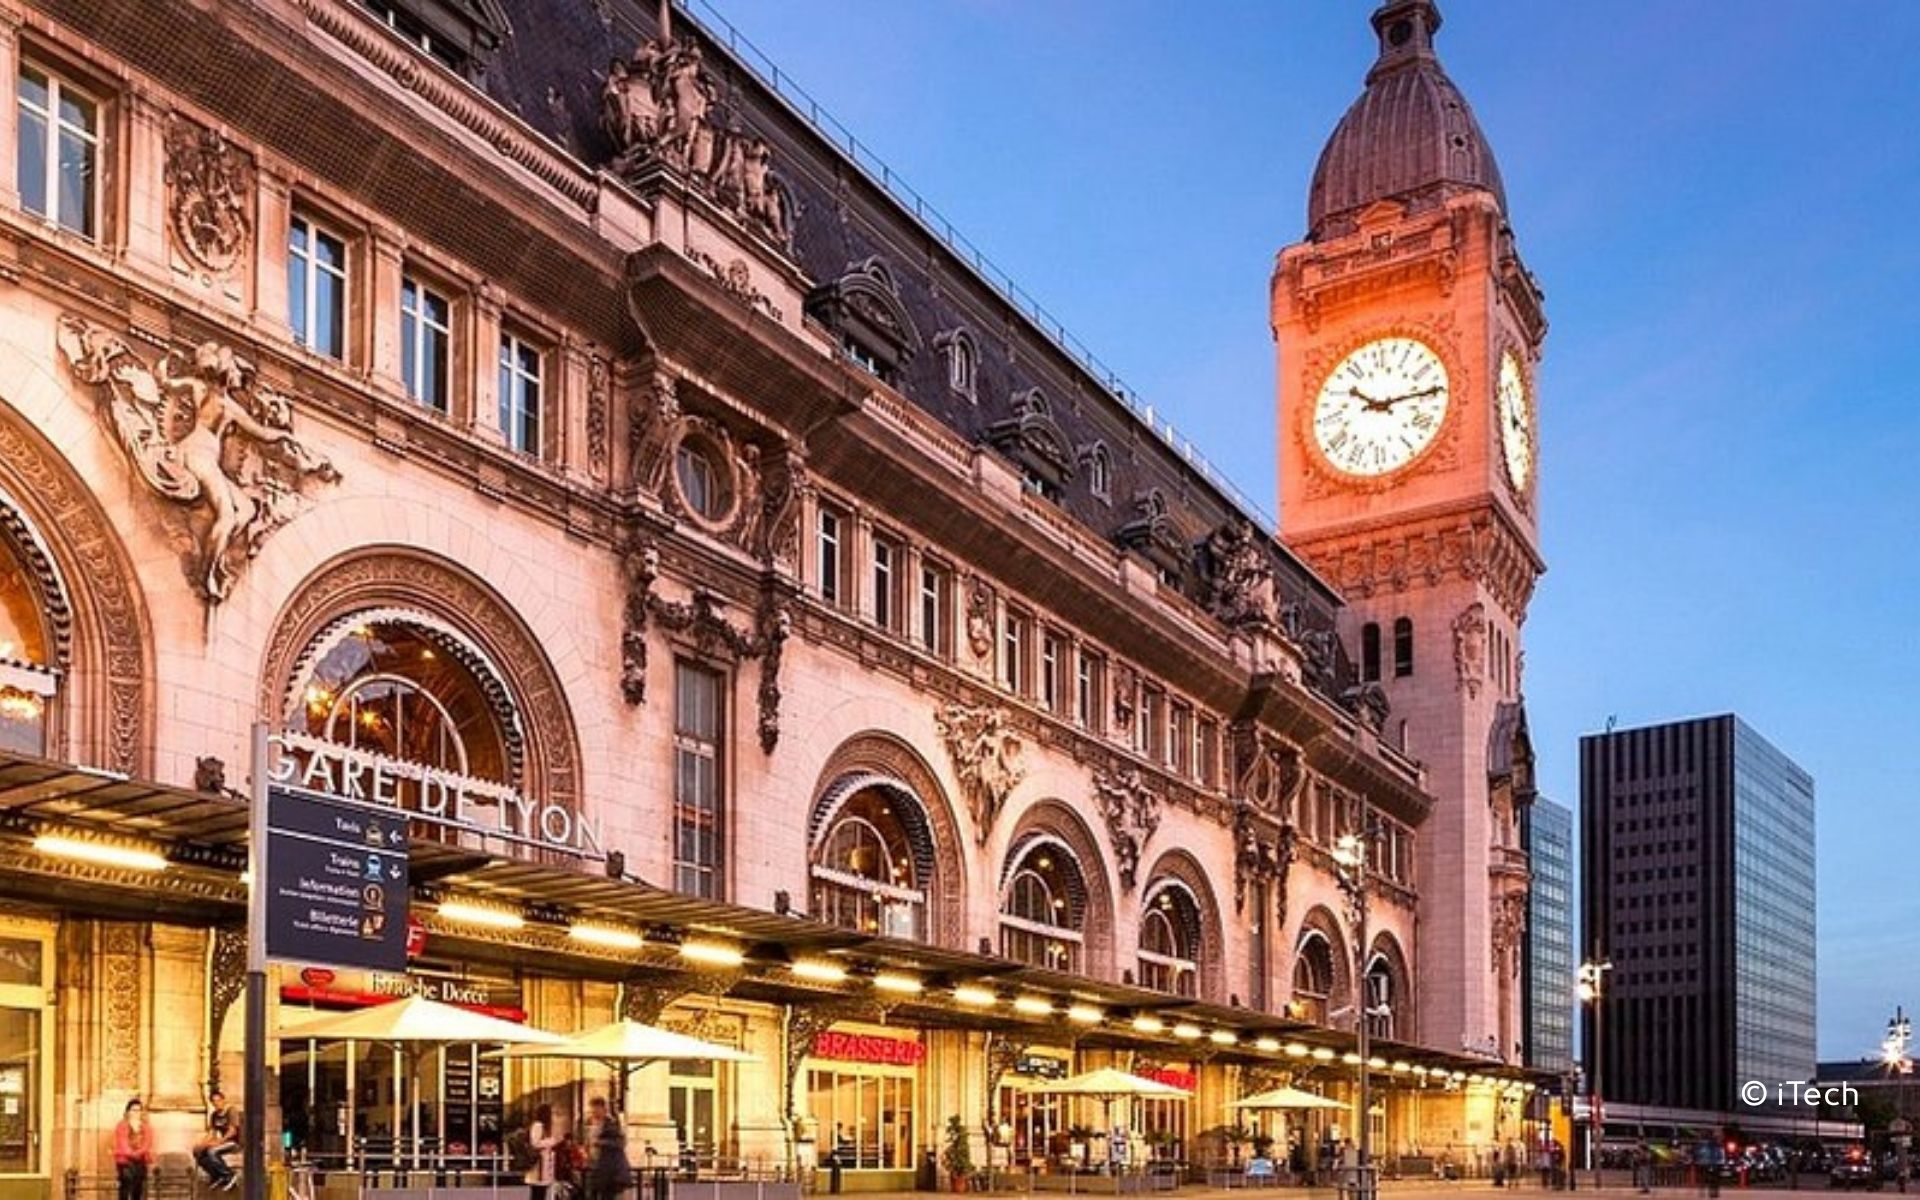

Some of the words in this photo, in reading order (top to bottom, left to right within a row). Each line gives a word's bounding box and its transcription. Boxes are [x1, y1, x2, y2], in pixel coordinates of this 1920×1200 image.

[267, 735, 396, 804] GARE
[421, 770, 476, 824] DE
[498, 791, 603, 853] LYON
[299, 877, 360, 898] Information
[816, 1031, 925, 1063] BRASSERIE
